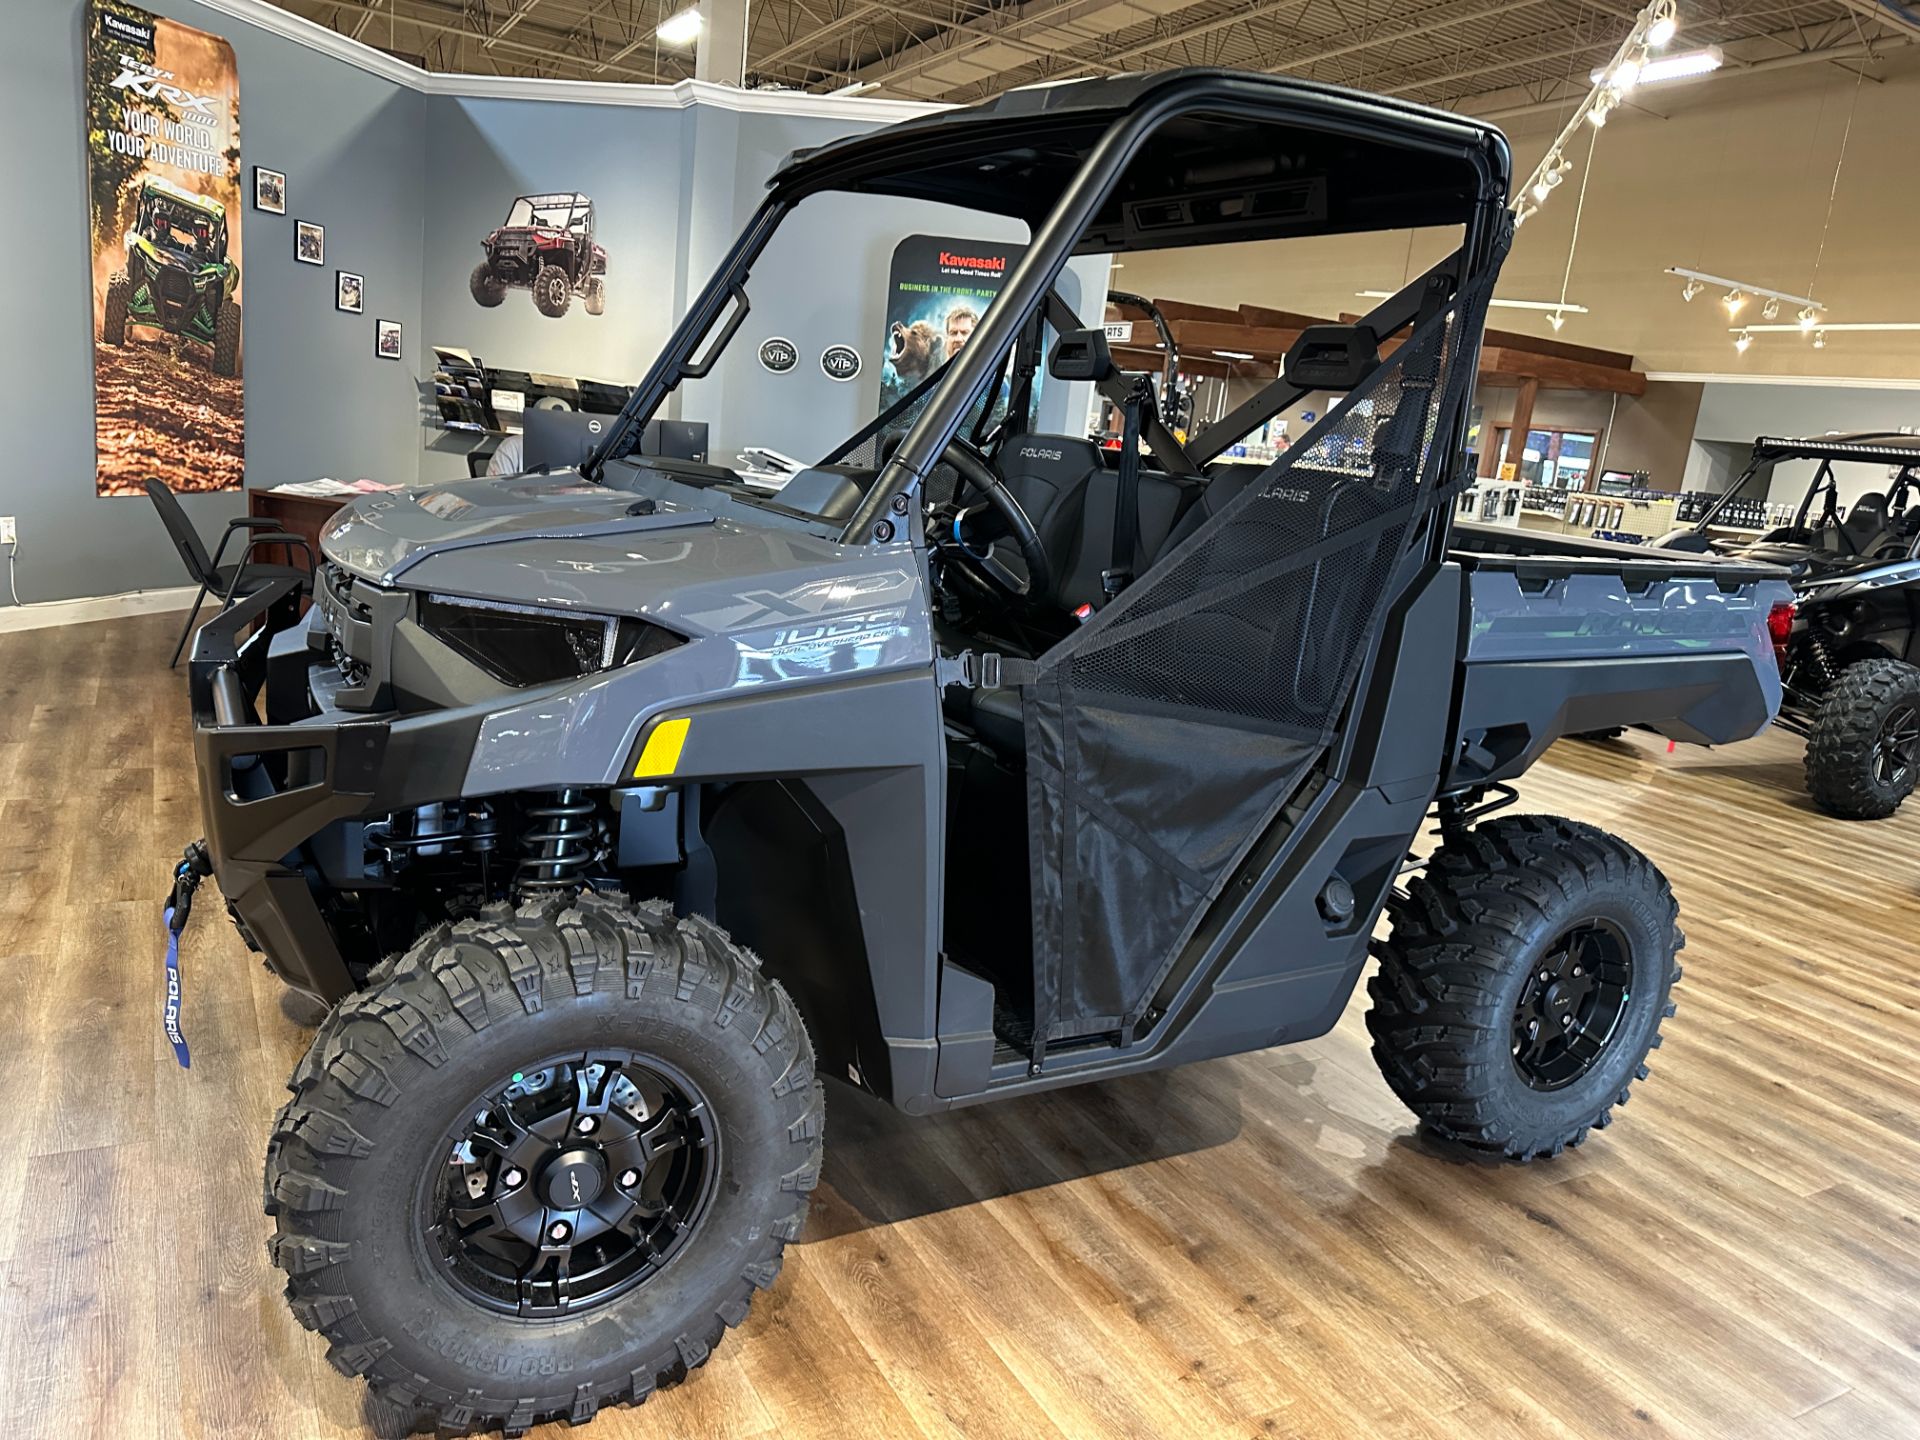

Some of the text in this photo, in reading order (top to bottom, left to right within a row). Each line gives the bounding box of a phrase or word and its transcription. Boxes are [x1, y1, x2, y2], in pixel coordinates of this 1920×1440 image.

[104, 14, 151, 40] Kawasaki
[109, 66, 218, 116] KRX
[182, 110, 218, 128] 1000
[122, 107, 214, 151] YOUR WORLD.
[107, 128, 225, 178] YOUR ADVENTURE.
[939, 252, 1005, 270] Kawasaki
[899, 282, 930, 293] BUSINESS
[940, 286, 952, 294] THE
[976, 290, 998, 298] PARTY
[768, 351, 788, 361] VIP
[830, 358, 850, 369] VIP
[1019, 447, 1063, 461] POLARIS
[1257, 485, 1310, 502] LARIS
[727, 568, 909, 627] XP
[166, 966, 184, 1044] POLARIS
